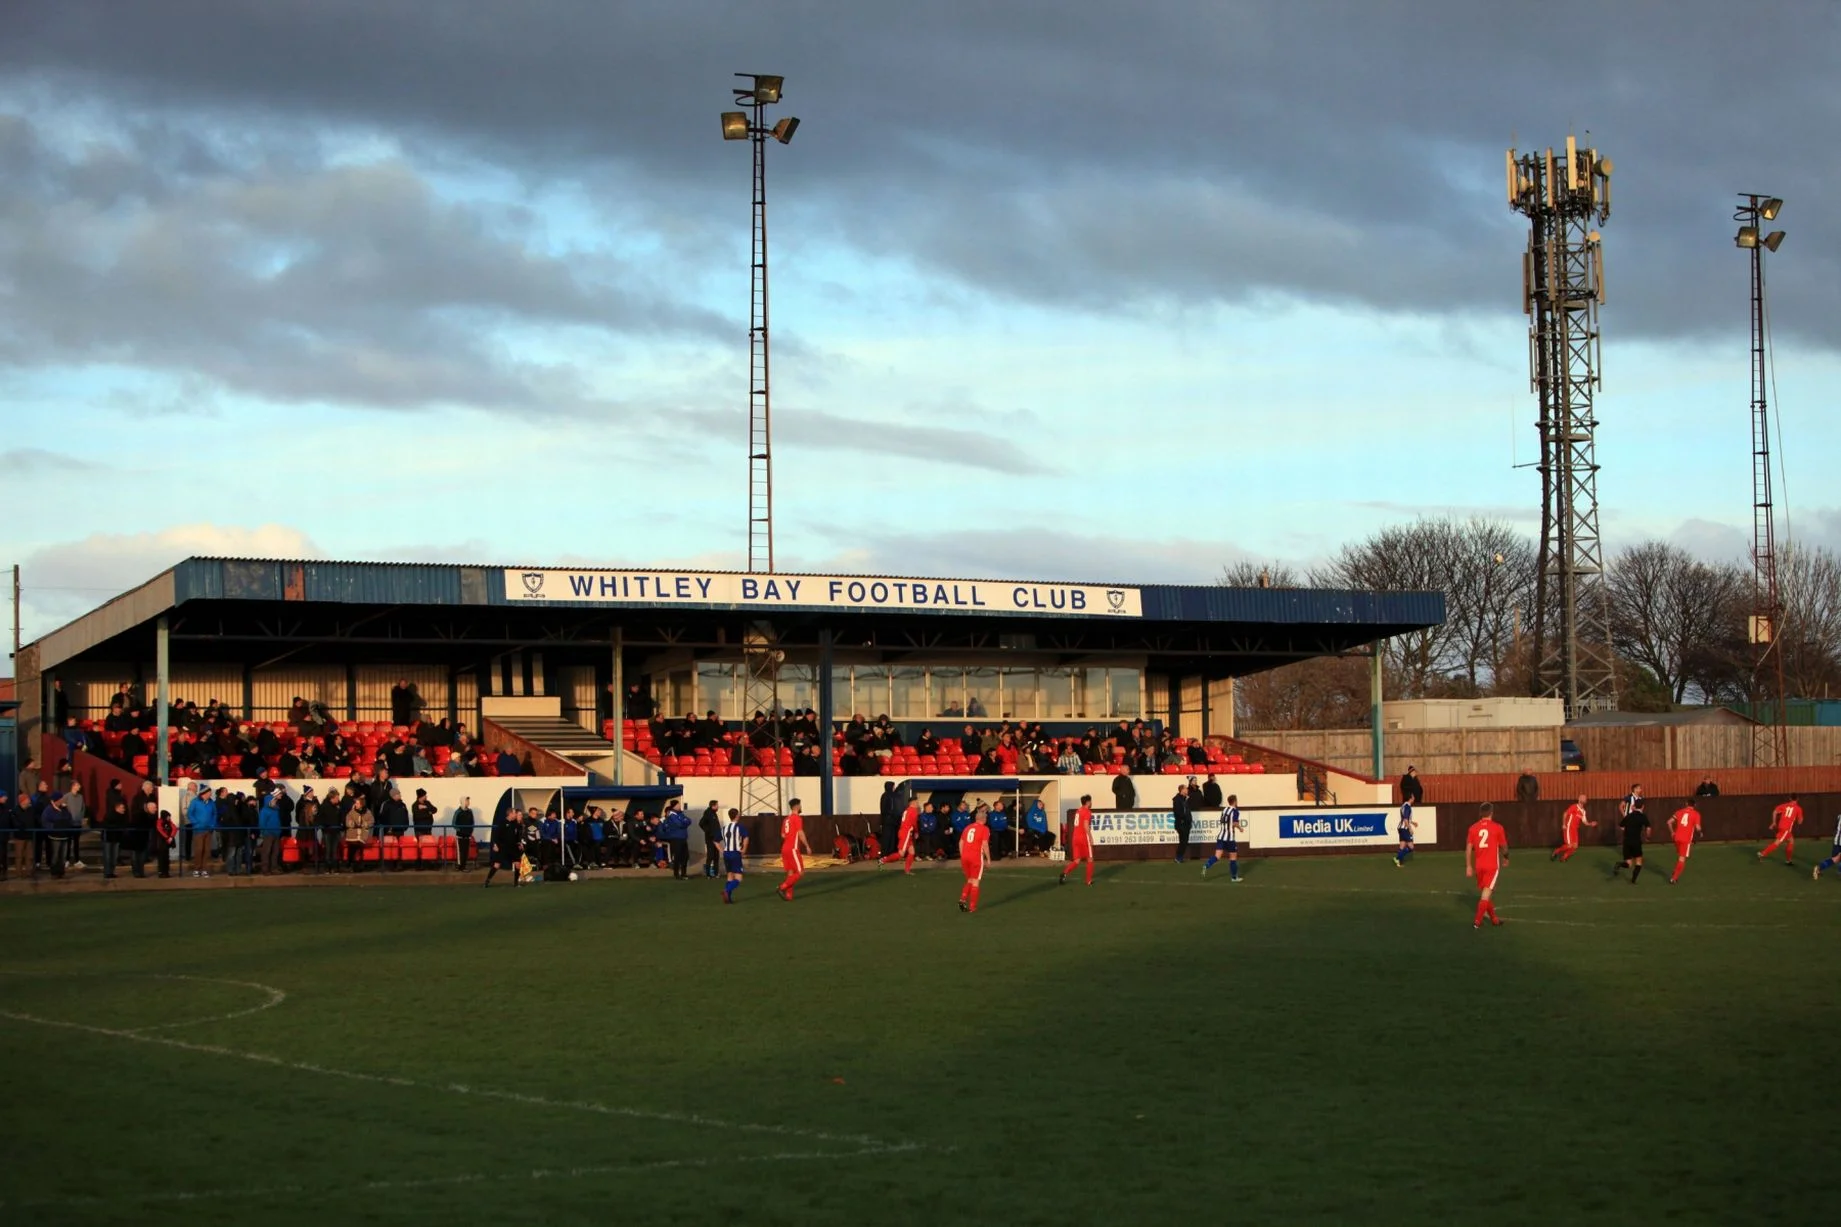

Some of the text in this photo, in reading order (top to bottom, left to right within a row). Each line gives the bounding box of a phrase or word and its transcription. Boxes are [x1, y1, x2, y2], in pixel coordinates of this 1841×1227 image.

[569, 575, 1086, 609] WHITLEY BAY FOOTBALL CLUB
[1293, 818, 1374, 834] Media UK Limited
[1680, 813, 1689, 827] 4
[966, 828, 976, 844] 6
[1478, 828, 1489, 849] 2
